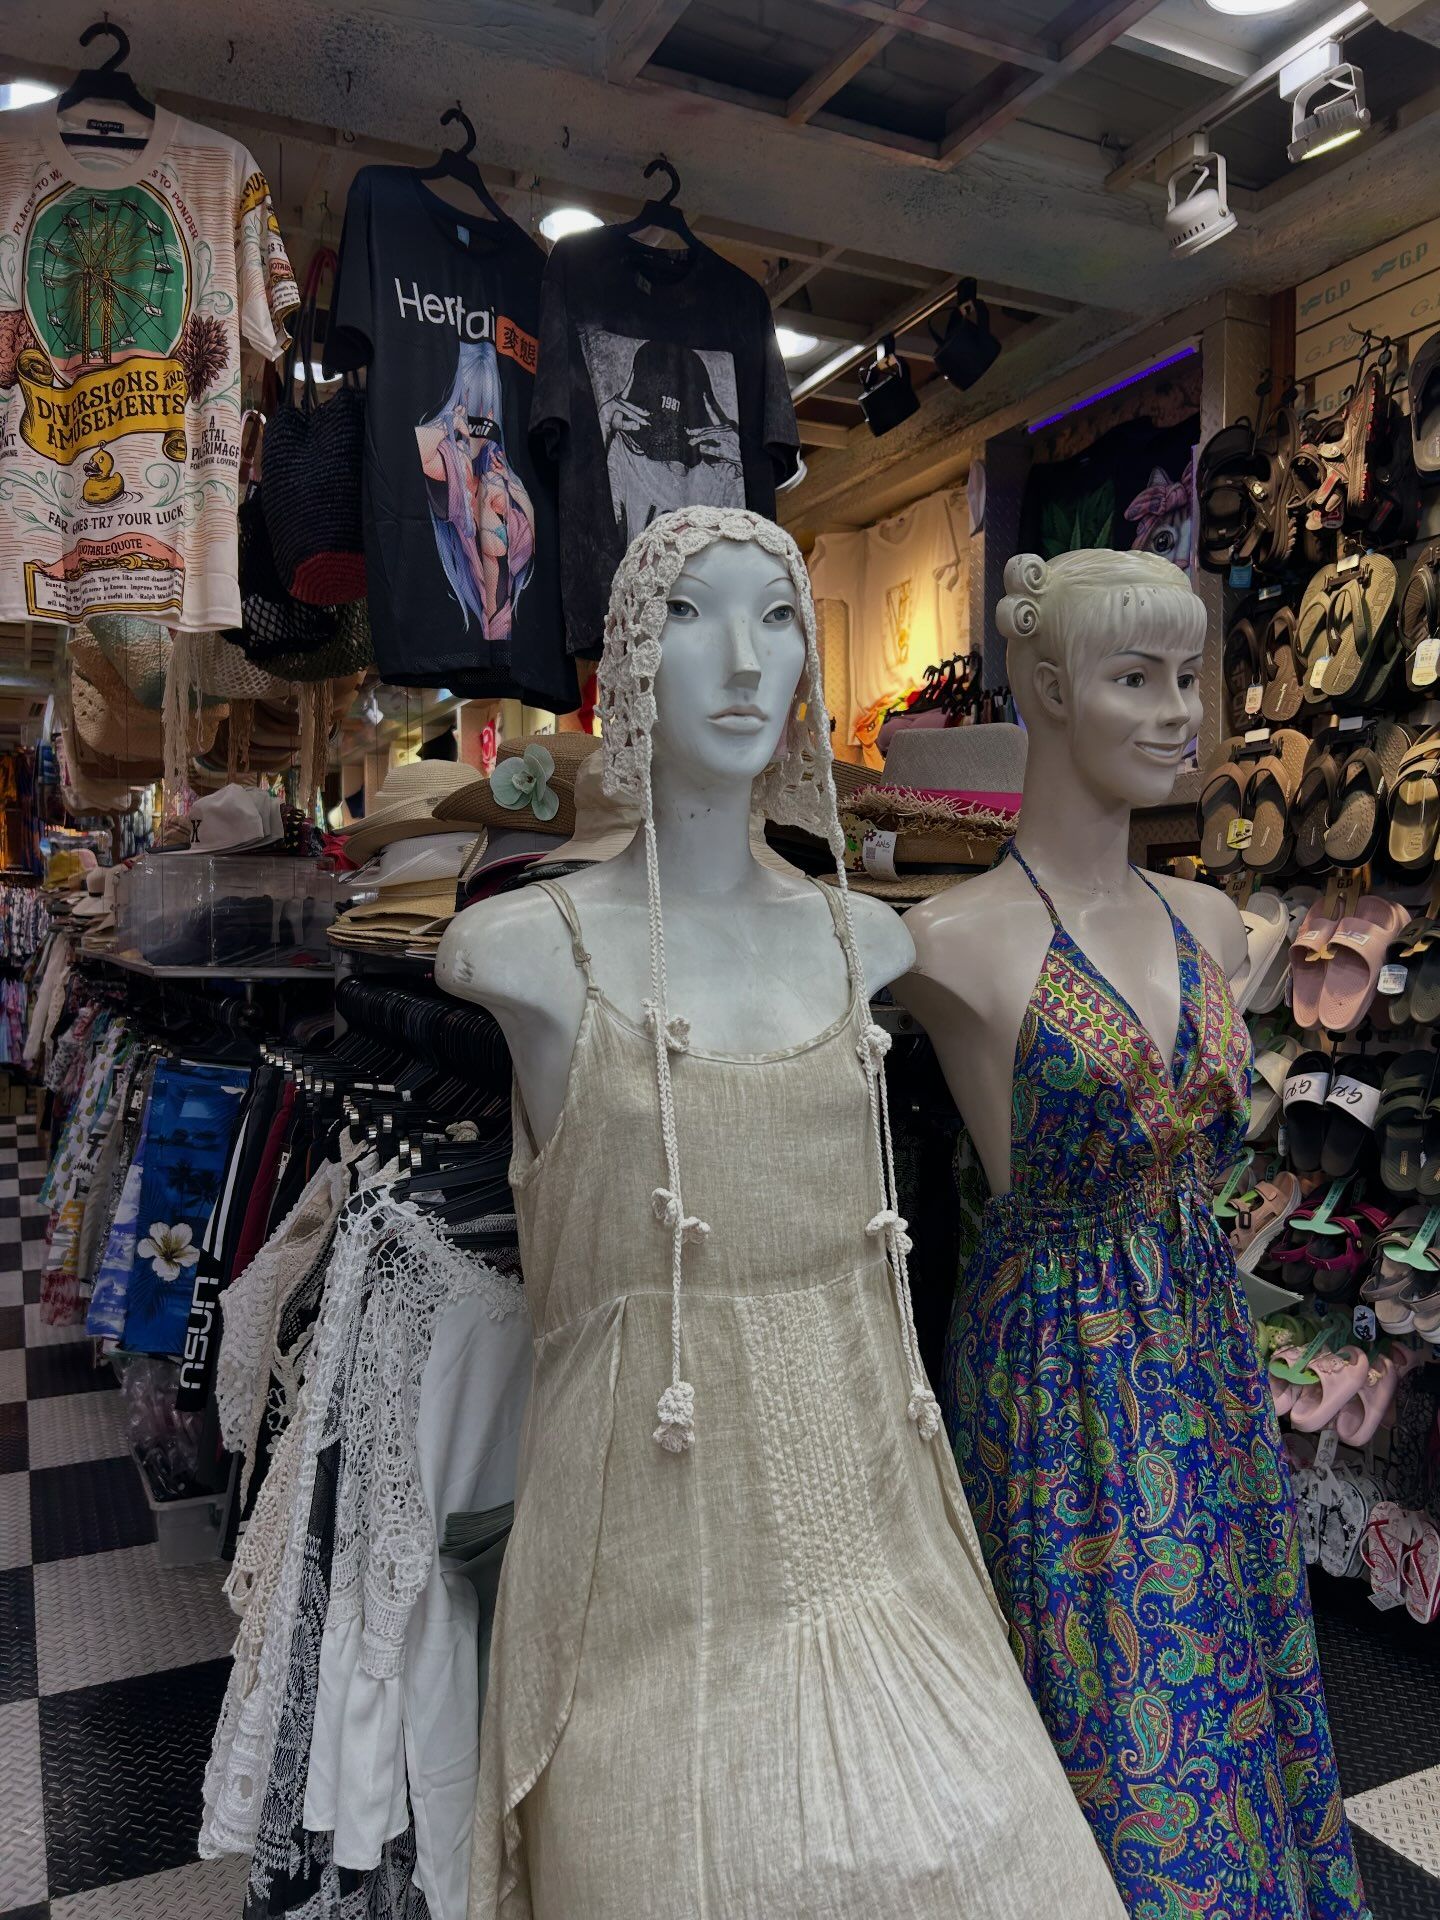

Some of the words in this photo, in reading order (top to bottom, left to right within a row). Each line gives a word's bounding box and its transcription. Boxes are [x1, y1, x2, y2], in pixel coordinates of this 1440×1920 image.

[35, 177, 49, 191] TO
[158, 173, 172, 189] TO
[172, 191, 200, 242] PONDER
[35, 370, 159, 427] DIVERSIONS
[163, 370, 184, 391] AND
[47, 393, 185, 451] AMUSEMENTS
[209, 415, 215, 429] A
[117, 512, 152, 526] YOUR
[155, 504, 184, 525] LUCK
[111, 539, 143, 554] QUOTE
